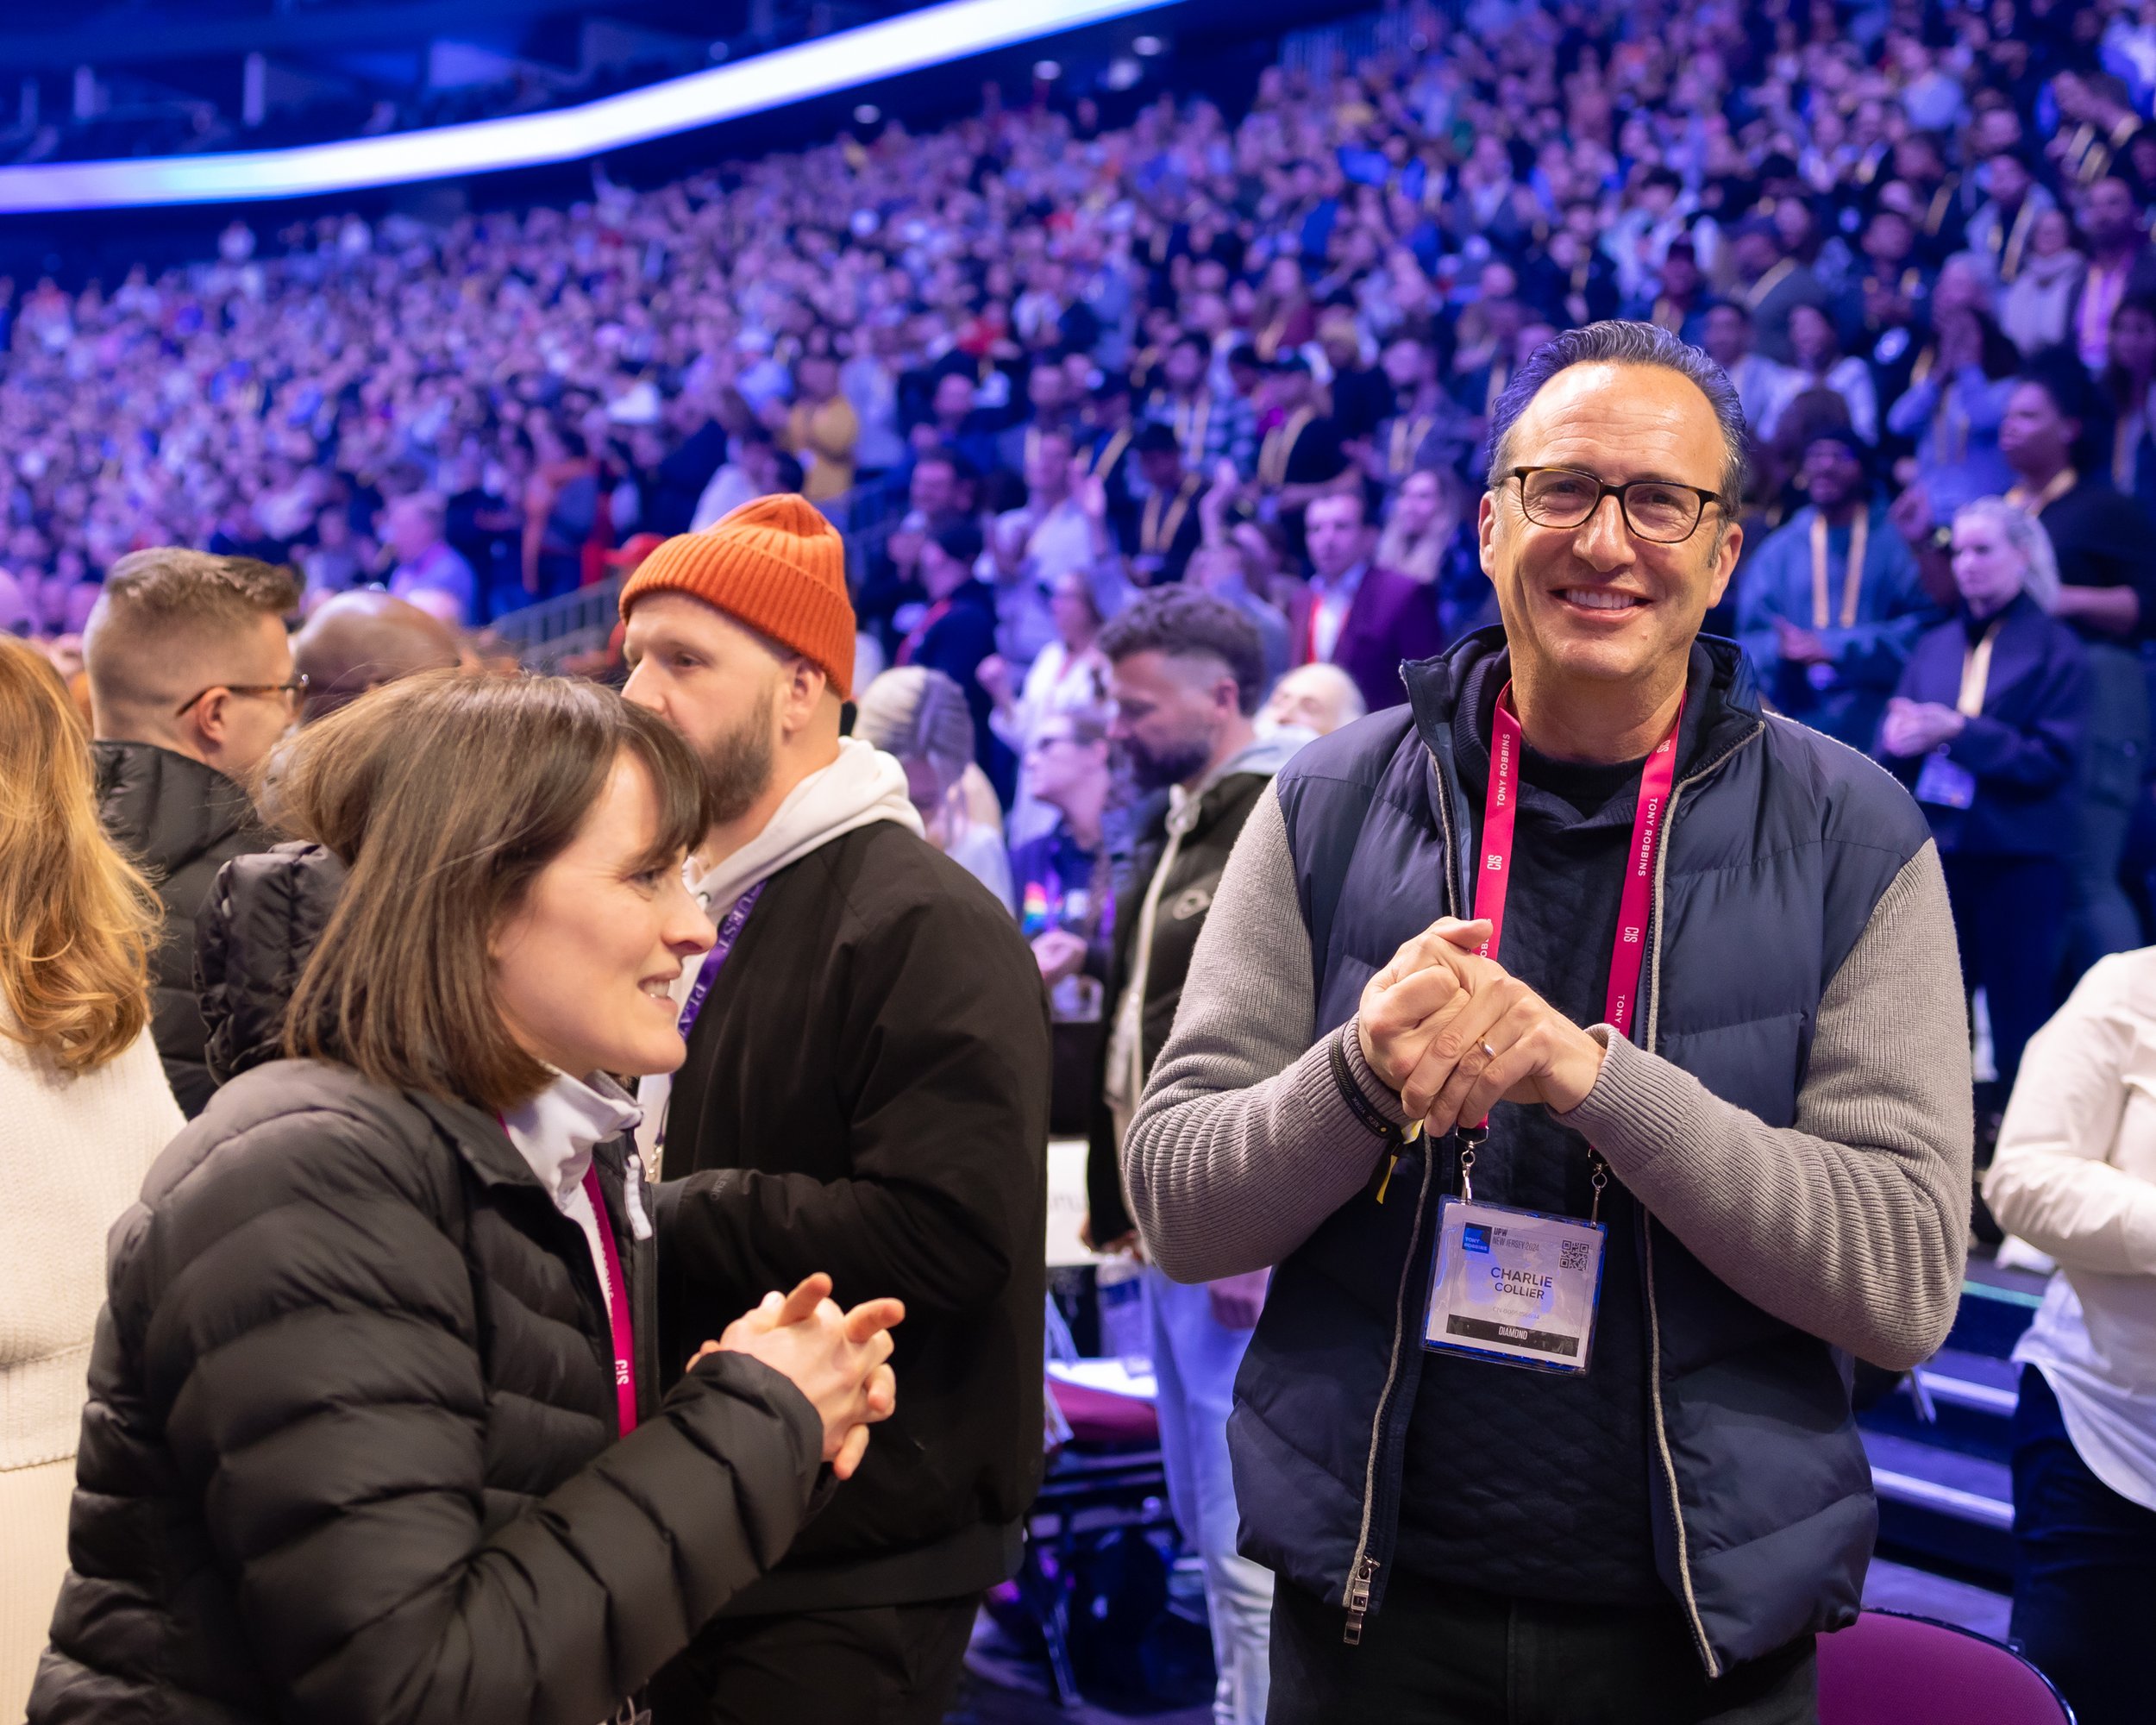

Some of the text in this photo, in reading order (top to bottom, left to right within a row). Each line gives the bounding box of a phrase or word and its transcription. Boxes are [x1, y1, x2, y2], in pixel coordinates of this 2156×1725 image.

[1496, 733, 1511, 807] TONY ROBBINS
[1638, 797, 1659, 877] TONY ROBBINS
[1486, 854, 1502, 871] CIS
[1623, 926, 1639, 944] CIS
[1614, 994, 1626, 1024] TONY
[1494, 1227, 1508, 1237] UPW
[1493, 1237, 1539, 1252] NEW JERSEY 2024
[1490, 1266, 1553, 1289] CHARLIE
[1495, 1282, 1545, 1300] COLLIER
[1498, 1326, 1528, 1340] DIAMOND
